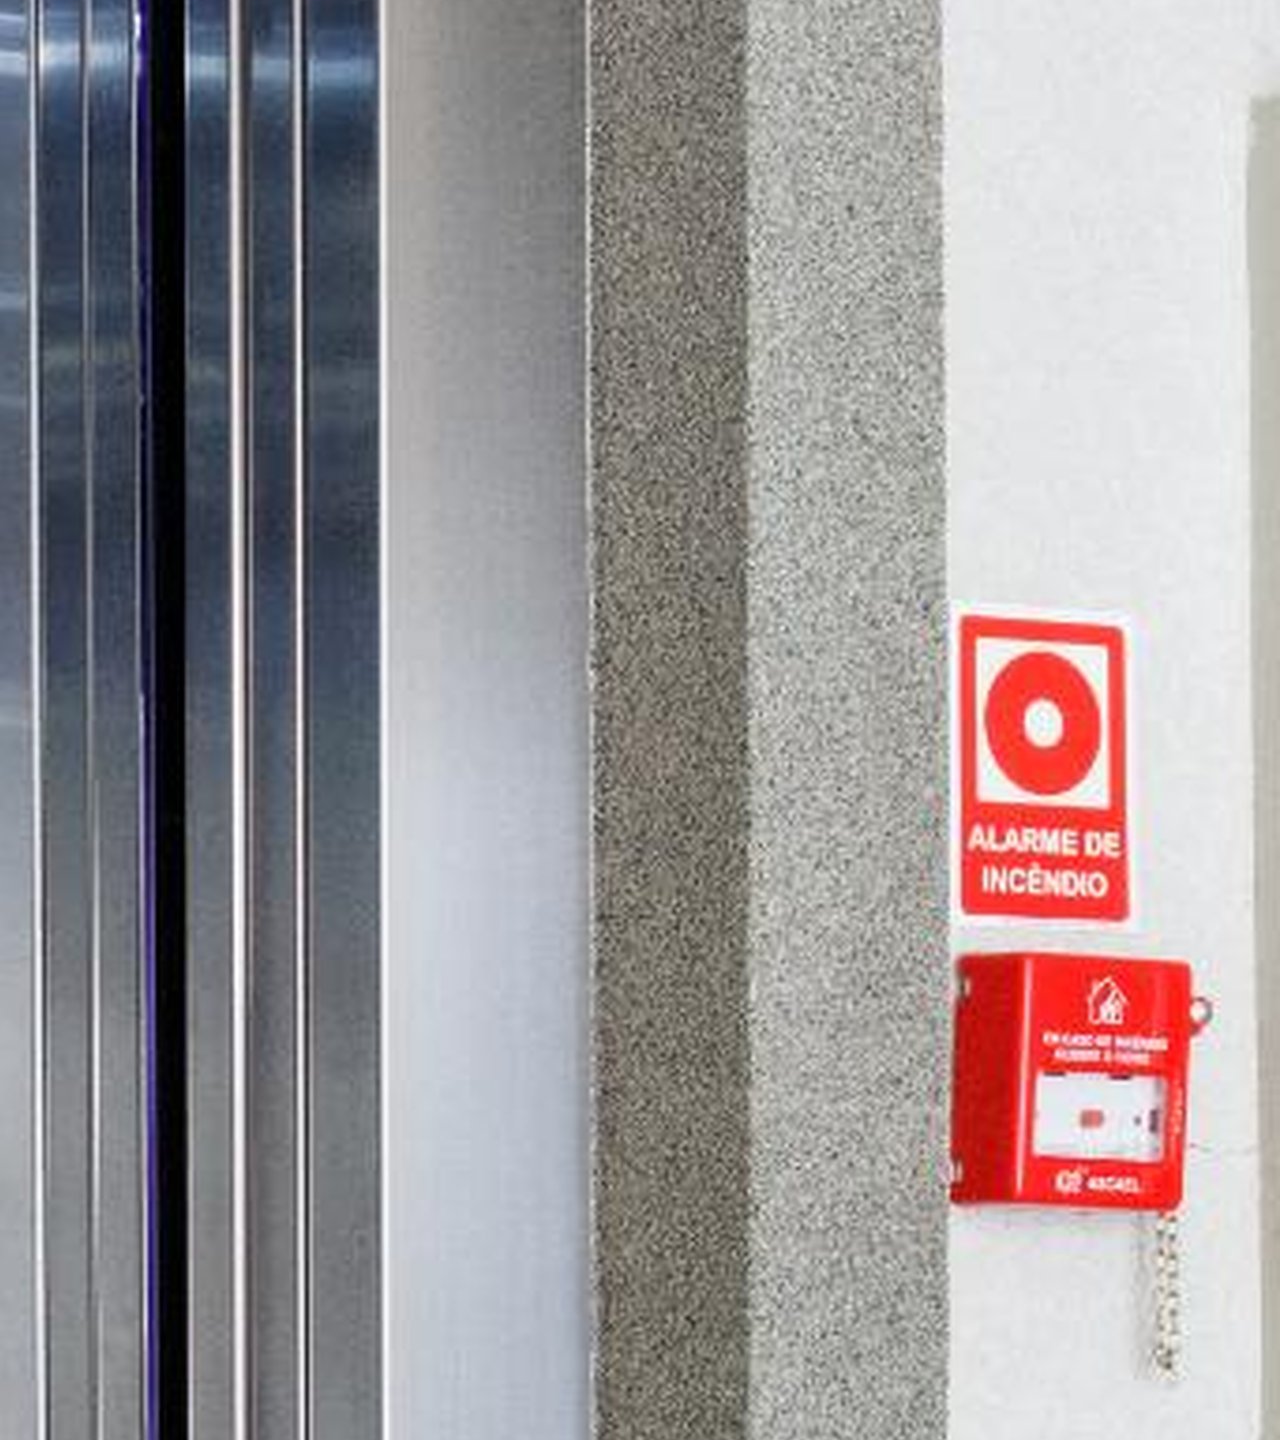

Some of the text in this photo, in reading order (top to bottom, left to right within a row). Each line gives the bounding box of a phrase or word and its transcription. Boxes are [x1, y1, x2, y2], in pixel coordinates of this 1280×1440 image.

[968, 824, 1121, 858] ALARME DE
[981, 863, 1109, 897] INCÊNDIO
